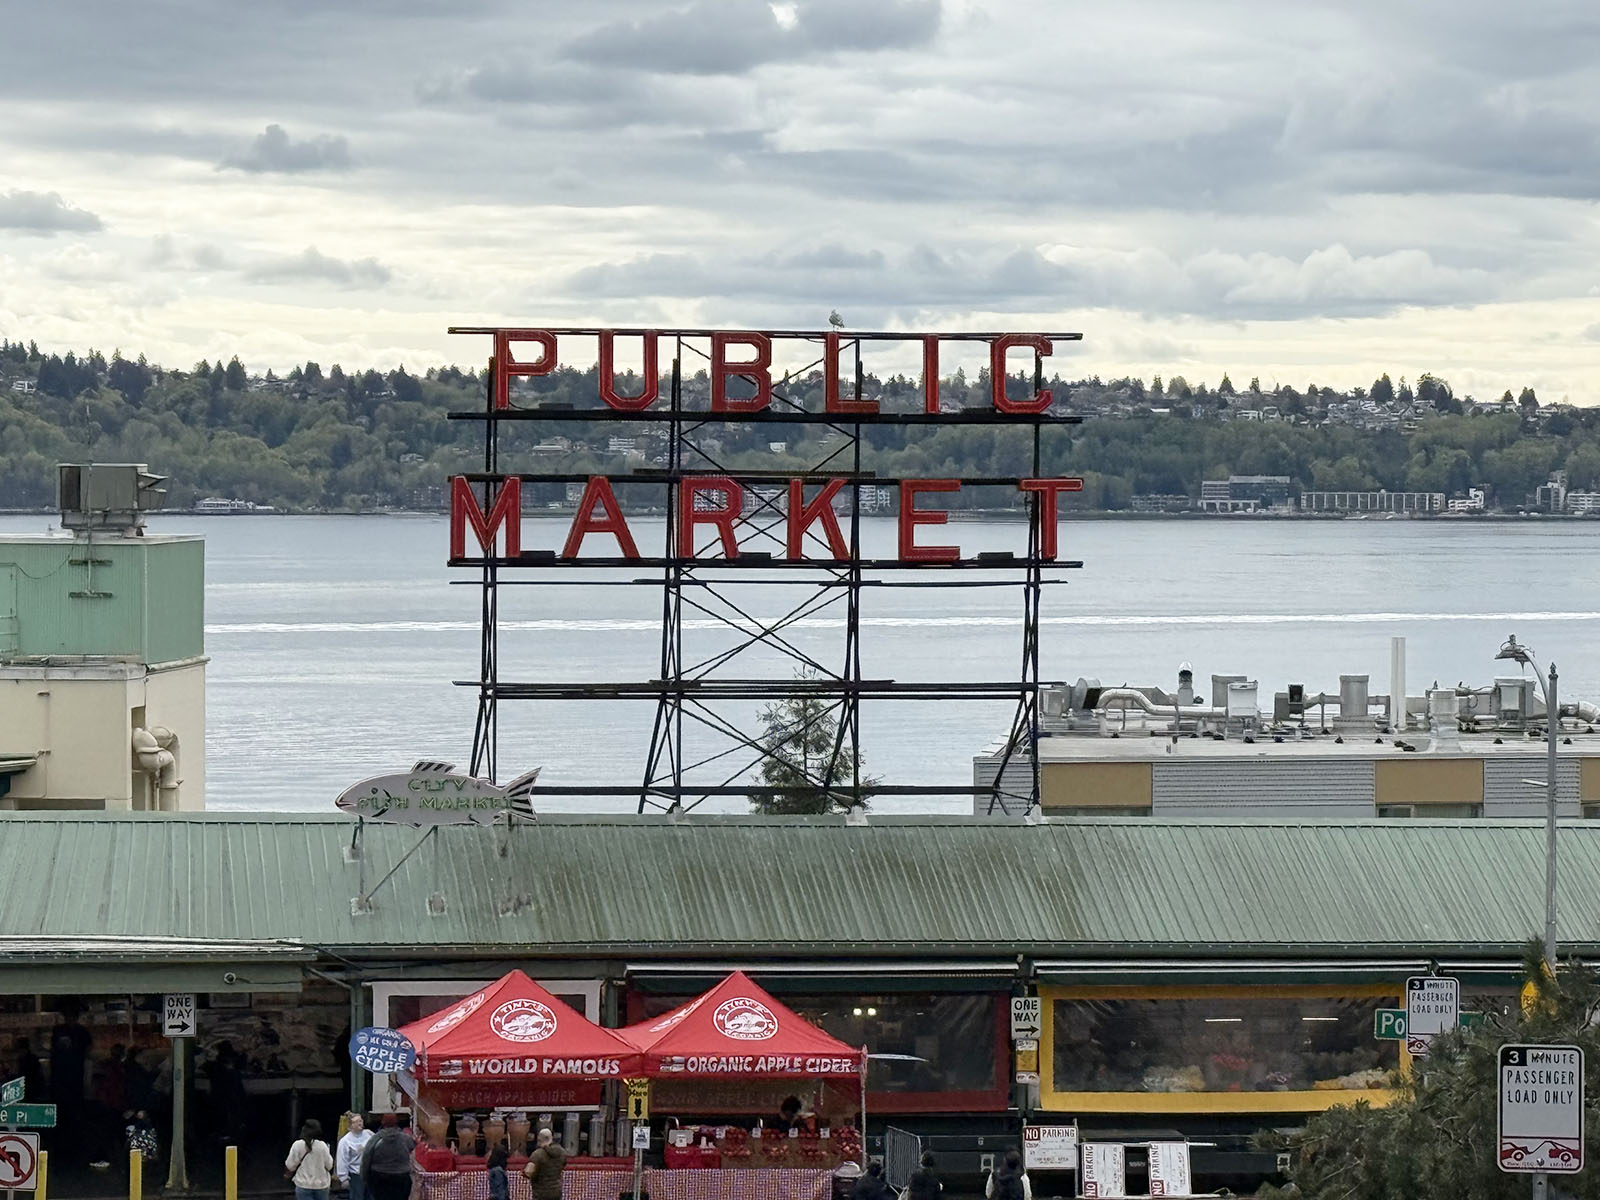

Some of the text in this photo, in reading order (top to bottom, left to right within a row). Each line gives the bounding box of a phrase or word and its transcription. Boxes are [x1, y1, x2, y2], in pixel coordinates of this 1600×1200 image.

[495, 330, 1053, 414] PUBLIC
[450, 475, 1084, 562] MARKET
[407, 778, 467, 791] CITY
[357, 797, 514, 810] FISH MARKET
[1413, 981, 1420, 989] 3
[167, 997, 192, 1008] ONE
[1412, 992, 1454, 1002] PASSENGER
[1014, 999, 1038, 1010] ONE
[1412, 1005, 1453, 1014] LOAD ONLY
[167, 1009, 193, 1020] WAY
[1013, 1012, 1039, 1022] WAY
[357, 1045, 408, 1063] APPLE
[1508, 1051, 1575, 1064] 3 MINUTE
[355, 1055, 405, 1072] CIDER
[468, 1059, 621, 1074] WORLD FAMOUS
[686, 1056, 853, 1073] ORGANIC APPLE CIDER
[1507, 1070, 1575, 1085] PASSENGER
[1508, 1089, 1573, 1104] LOAD ONLY
[1025, 1128, 1075, 1140] NO PARKING
[1085, 1145, 1097, 1197] NO PARKING
[1152, 1181, 1163, 1196] NO
